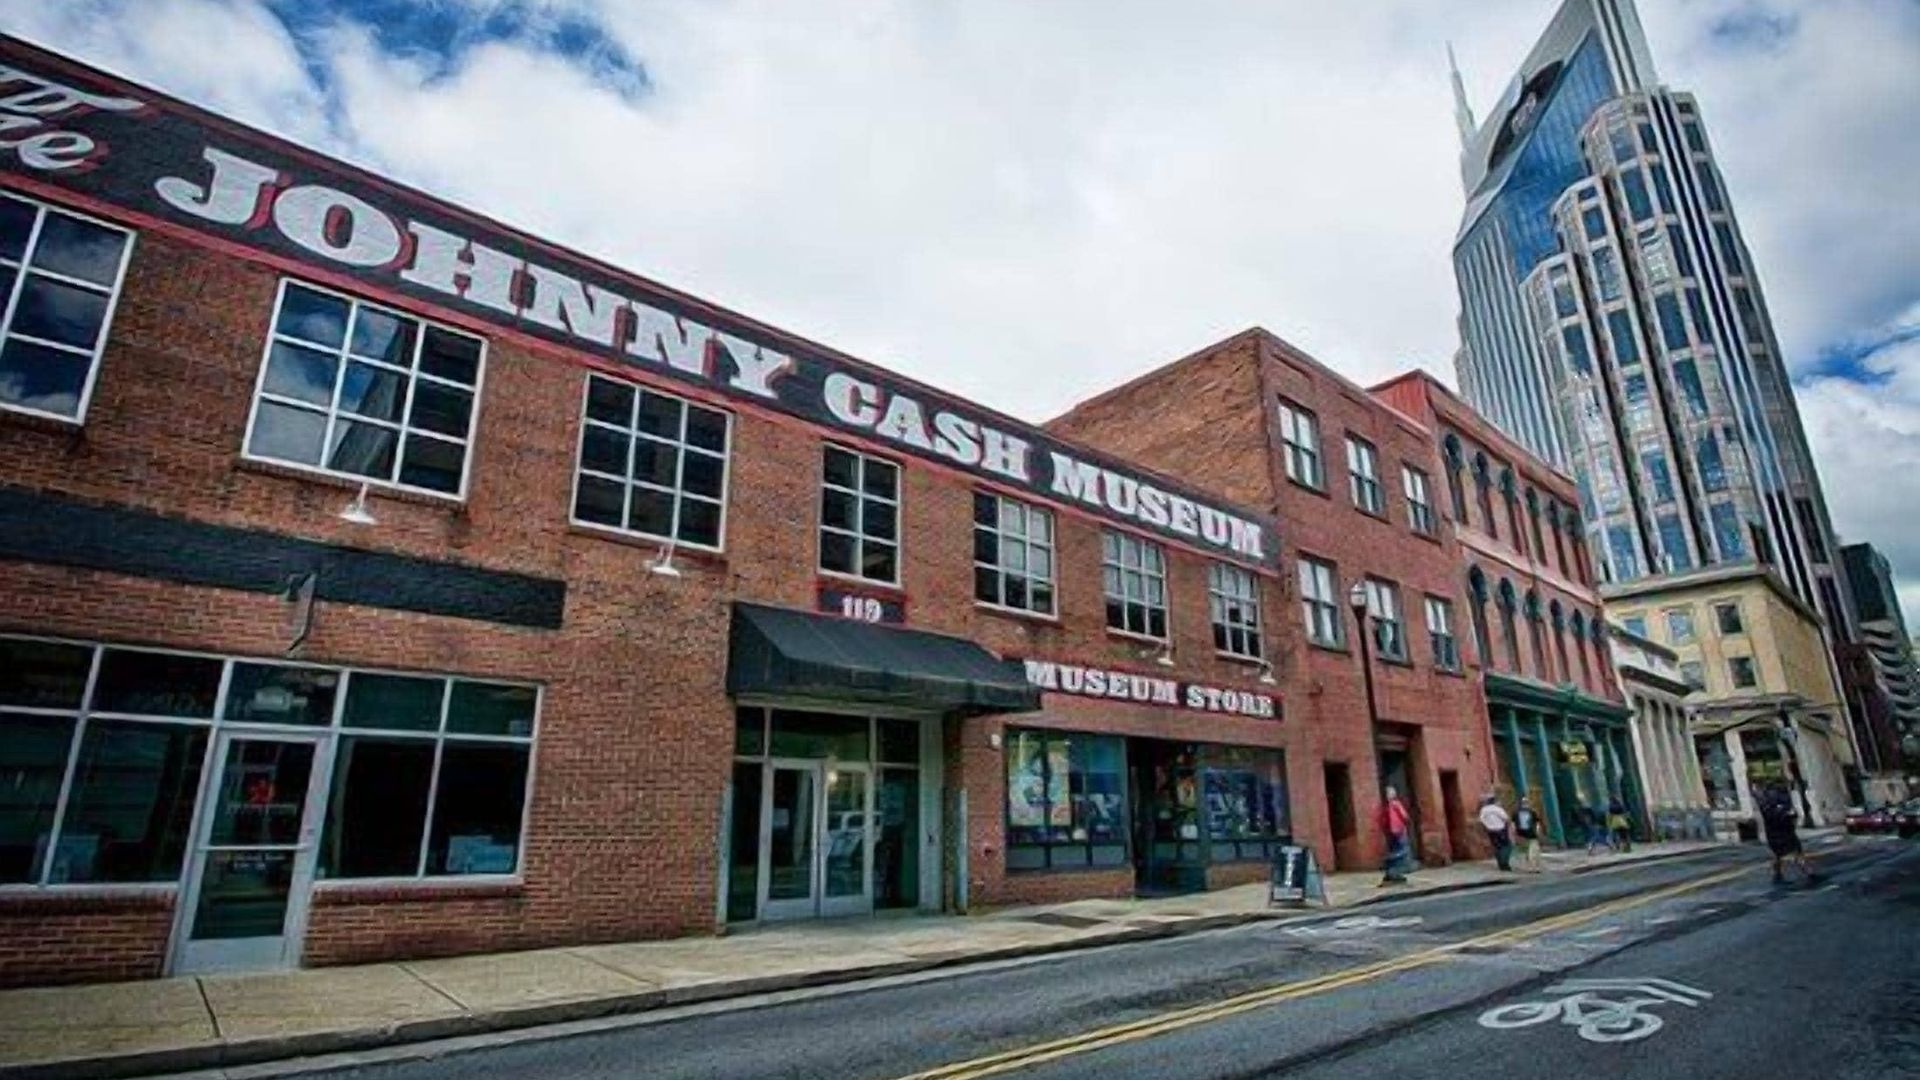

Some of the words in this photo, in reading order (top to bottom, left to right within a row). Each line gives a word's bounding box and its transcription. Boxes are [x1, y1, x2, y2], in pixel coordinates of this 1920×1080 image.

[155, 146, 796, 399] JOHNNY
[823, 372, 1030, 483] CASH
[1050, 451, 1265, 560] MUSEUM
[1024, 660, 1178, 704] MUSEUM
[1186, 685, 1275, 718] STORE
